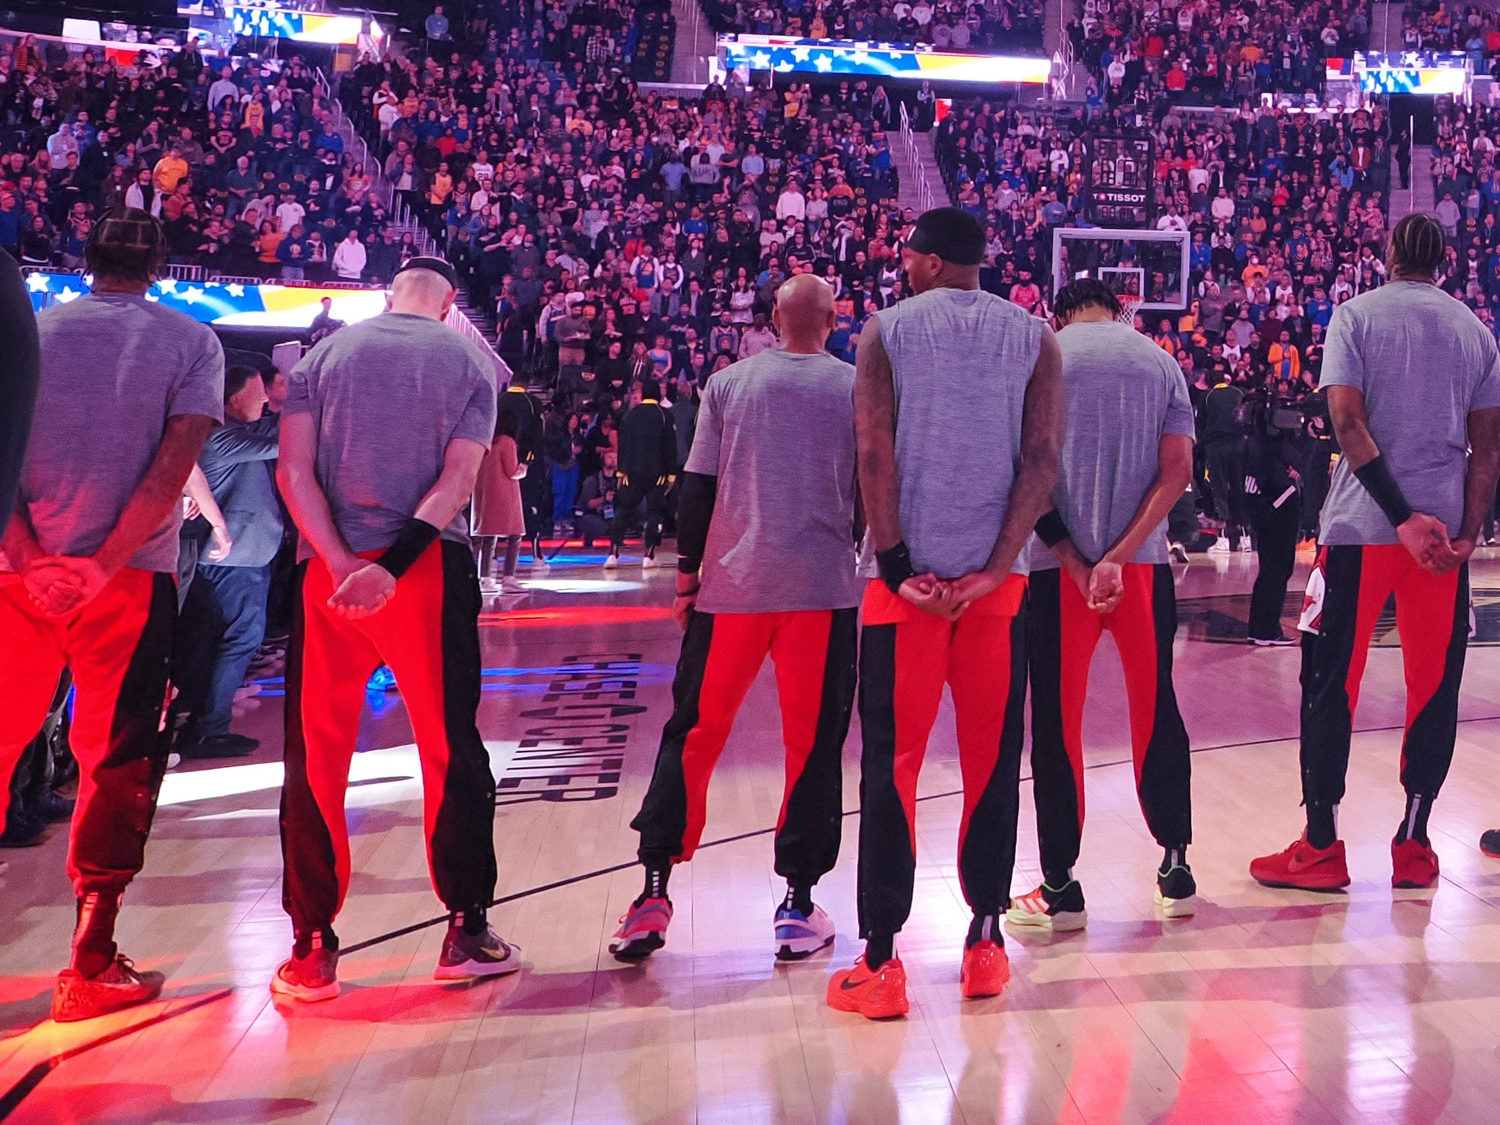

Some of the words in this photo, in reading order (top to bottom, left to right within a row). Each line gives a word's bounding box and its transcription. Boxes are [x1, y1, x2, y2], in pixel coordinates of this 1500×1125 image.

[1107, 193, 1147, 203] TISSOT
[541, 653, 643, 702] CHASE
[495, 724, 630, 805] CENTER
